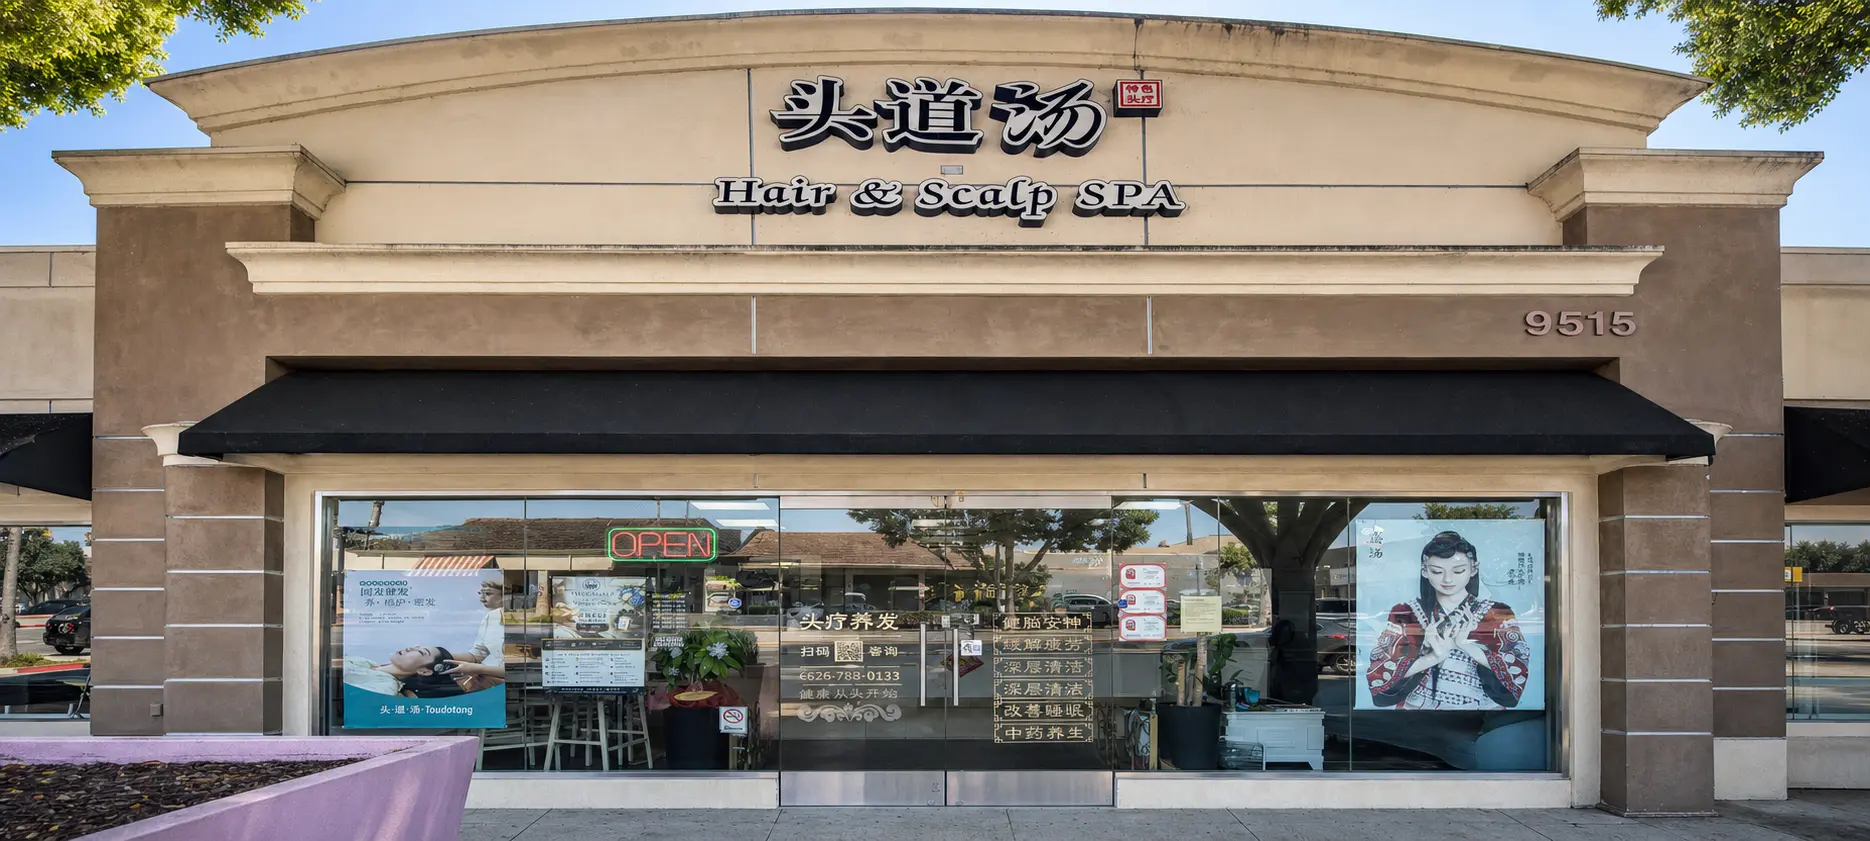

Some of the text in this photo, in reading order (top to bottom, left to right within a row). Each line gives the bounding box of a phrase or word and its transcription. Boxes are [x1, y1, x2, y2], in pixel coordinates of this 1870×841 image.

[770, 75, 1107, 157] 头道汤
[714, 176, 1187, 226] Hair & Scalp SPA
[1524, 310, 1637, 336] 9515
[611, 531, 711, 558] OPEN
[799, 612, 900, 631] 头疗养发
[800, 645, 830, 658] 扫码
[1005, 726, 1085, 741] 中药养生
